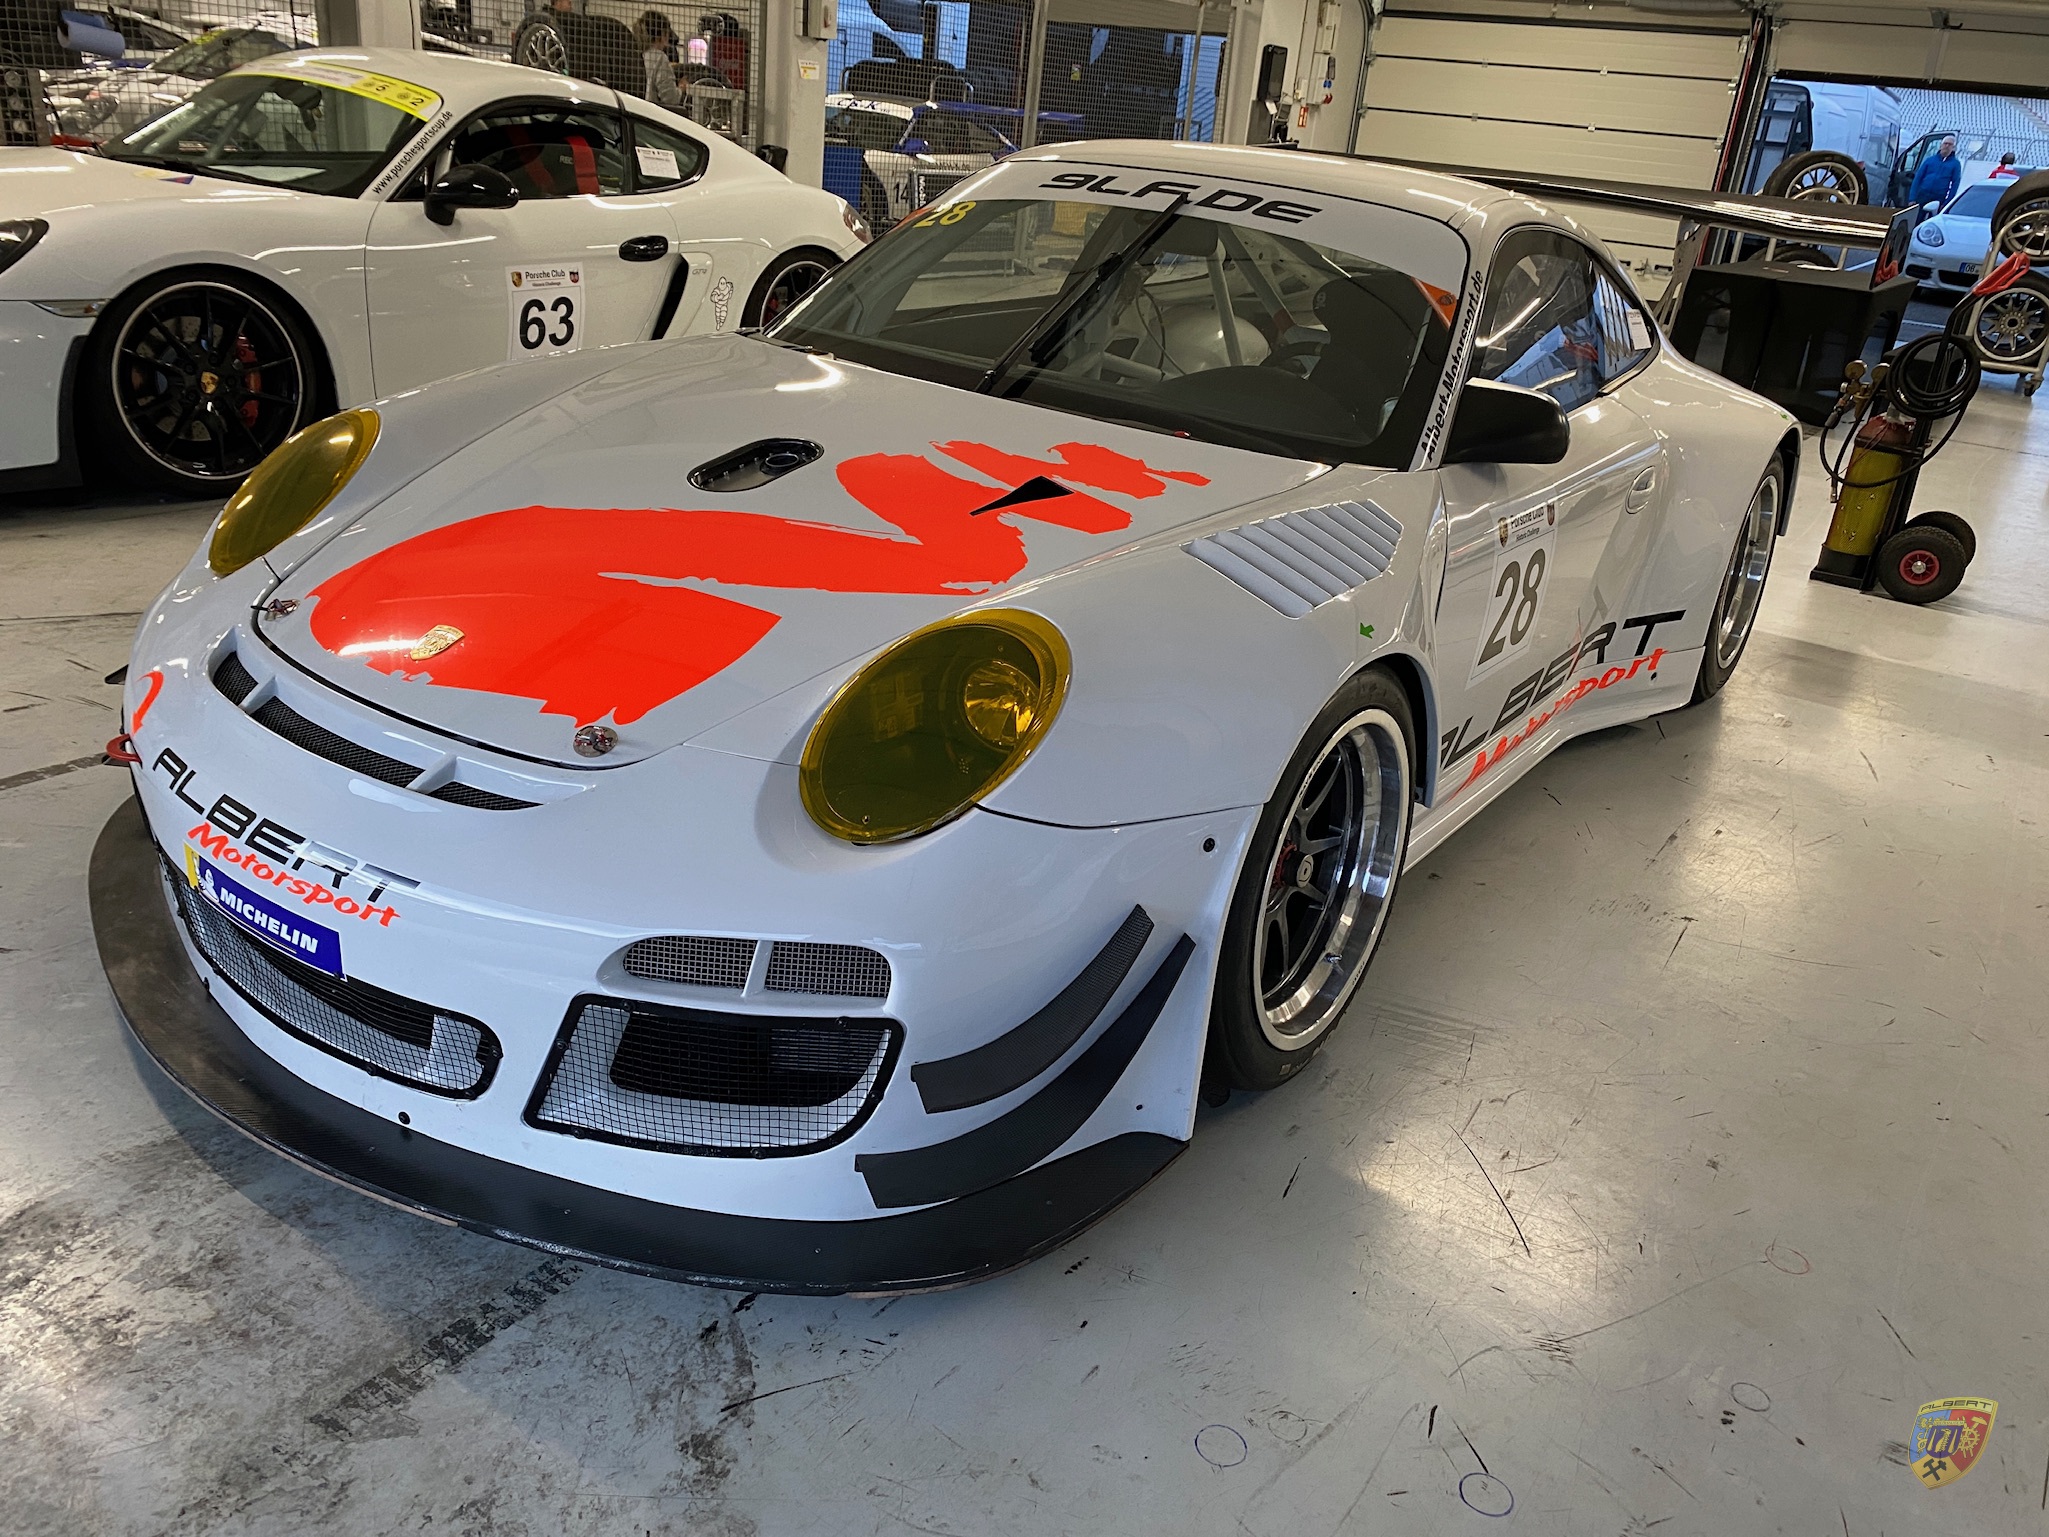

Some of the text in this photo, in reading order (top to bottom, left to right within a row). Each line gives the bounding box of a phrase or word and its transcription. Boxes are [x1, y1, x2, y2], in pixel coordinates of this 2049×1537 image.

[372, 110, 453, 194] www.porschesportscup.de
[894, 181, 909, 204] 14
[913, 201, 977, 228] 28
[525, 268, 565, 279] Porsche Club
[519, 296, 574, 350] 63
[1477, 548, 1546, 666] 28
[153, 747, 421, 903] ALBERT
[187, 821, 402, 928] Motorsport
[219, 887, 319, 953] MICHELIN
